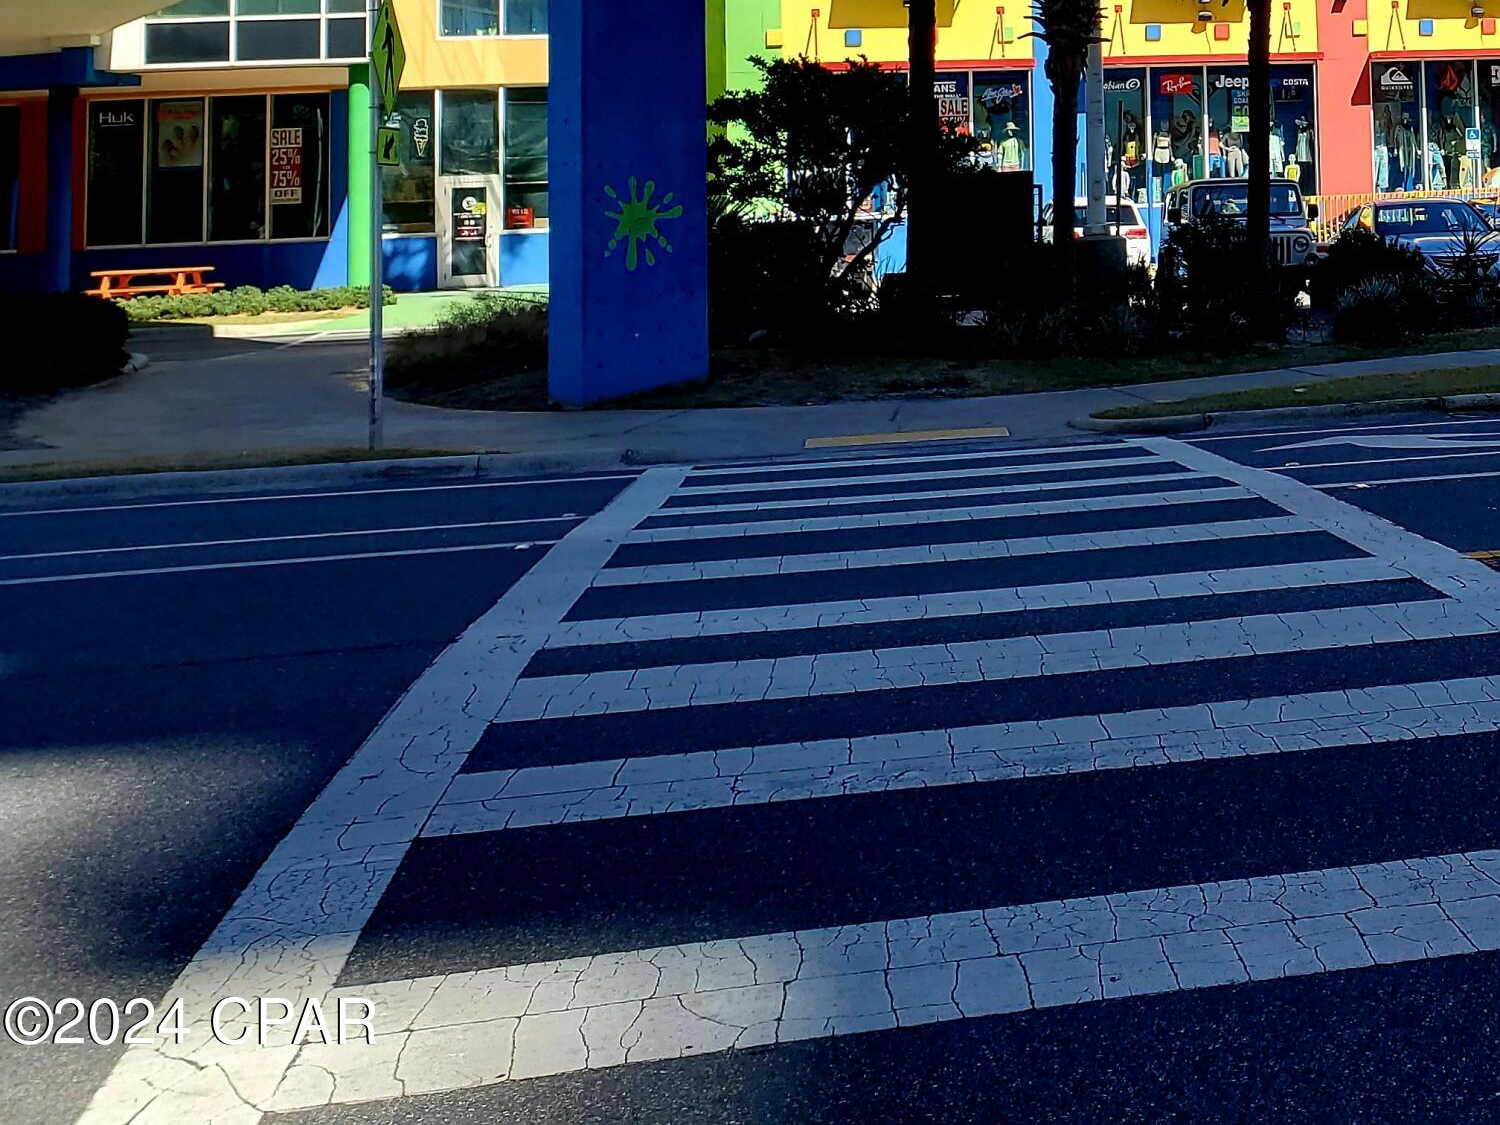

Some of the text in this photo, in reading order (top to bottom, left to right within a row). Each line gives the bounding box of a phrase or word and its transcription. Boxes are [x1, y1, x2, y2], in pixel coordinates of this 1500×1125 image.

[1283, 78, 1309, 86] COSTA
[941, 99, 968, 115] SALE
[272, 129, 301, 146] SALE
[272, 148, 301, 165] 25%
[272, 170, 301, 187] 75%
[275, 189, 298, 197] OFF
